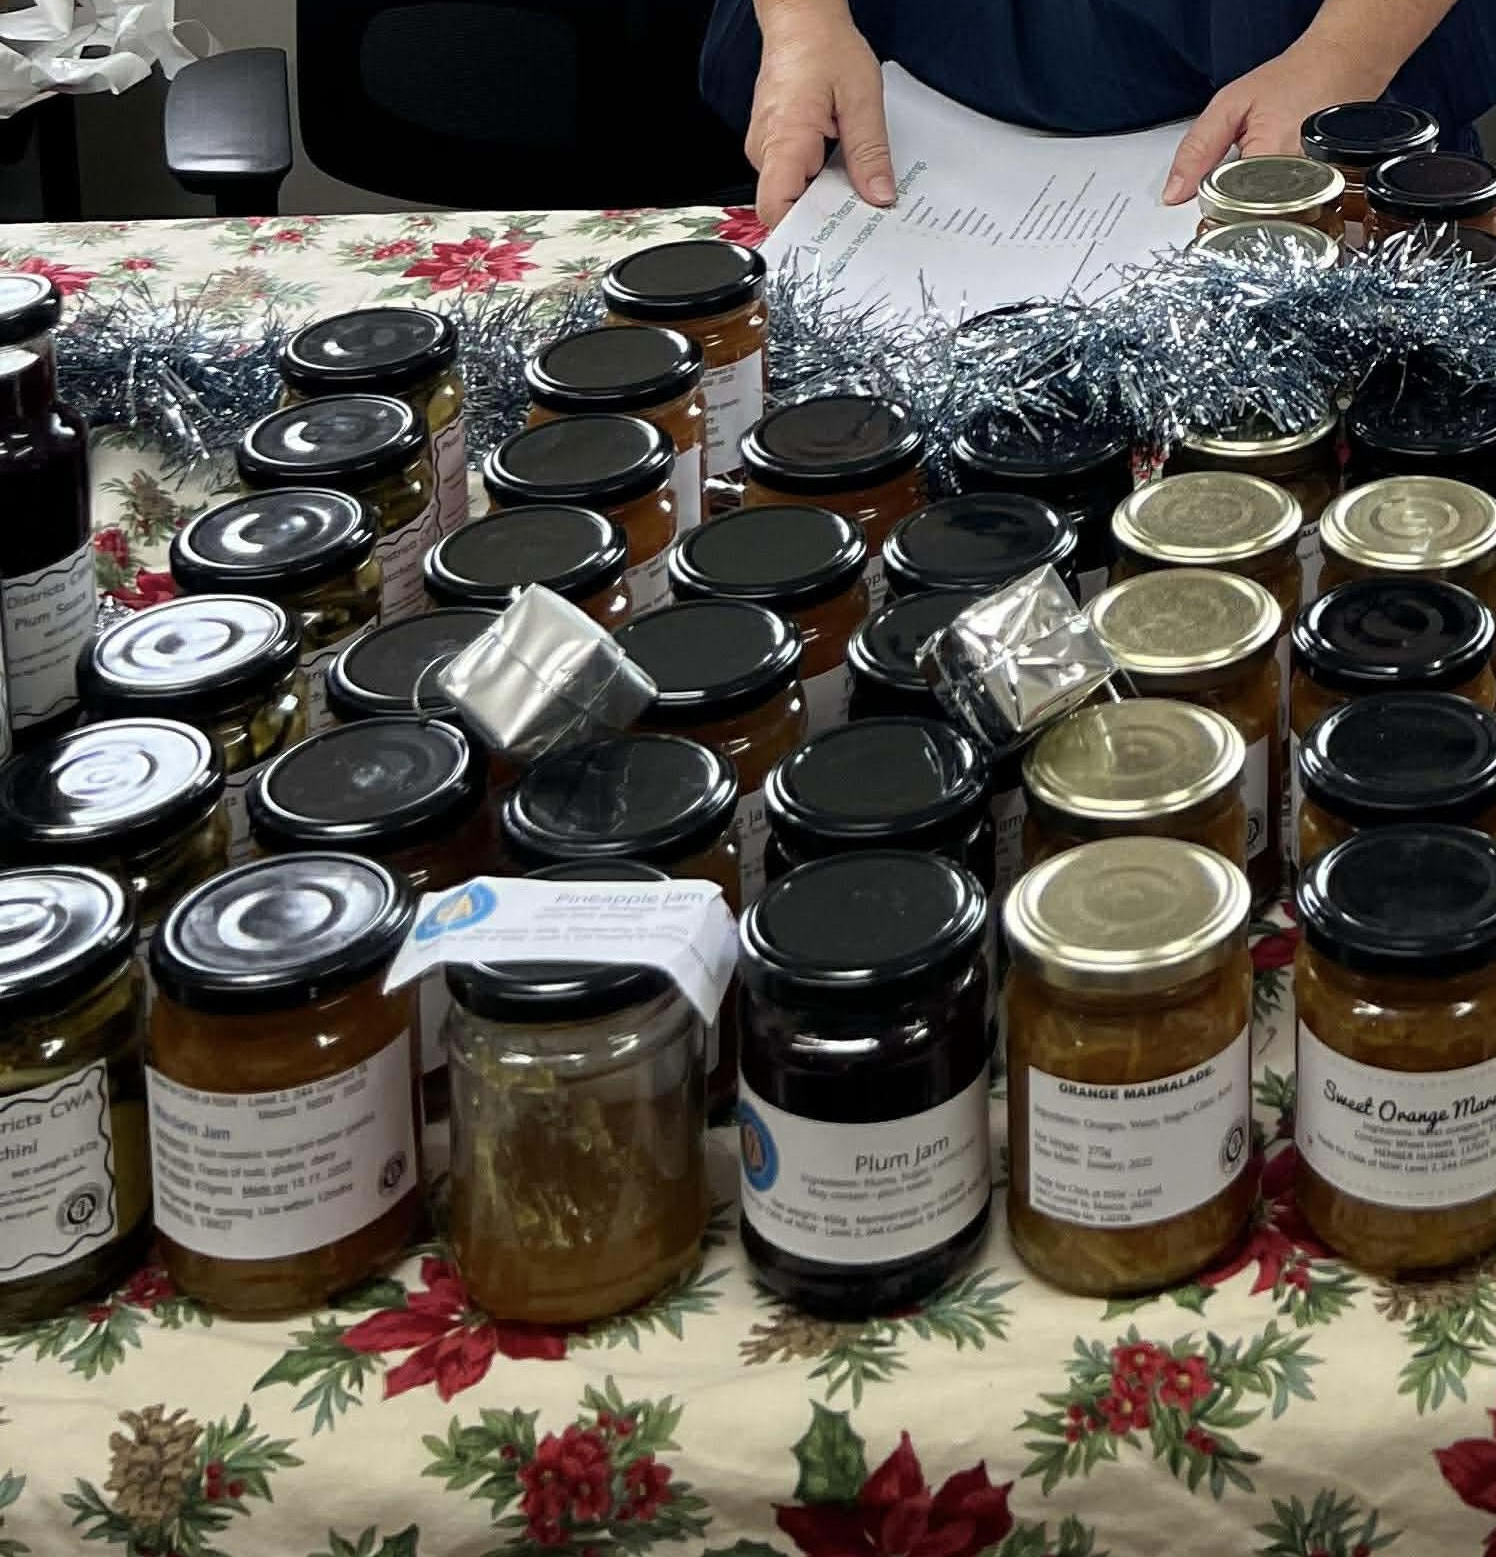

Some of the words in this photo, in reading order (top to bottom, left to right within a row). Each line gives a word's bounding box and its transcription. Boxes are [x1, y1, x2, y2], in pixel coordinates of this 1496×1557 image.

[554, 890, 658, 905] Pineapple
[1058, 1081, 1119, 1101] ORANGE
[0, 1114, 43, 1135] ricts
[50, 1089, 94, 1119] CWA
[1322, 1078, 1375, 1117] Sweet
[1377, 1099, 1450, 1134] Orange
[202, 1123, 231, 1141] Jam
[855, 1151, 909, 1174] Plum
[914, 1135, 950, 1168] Jam
